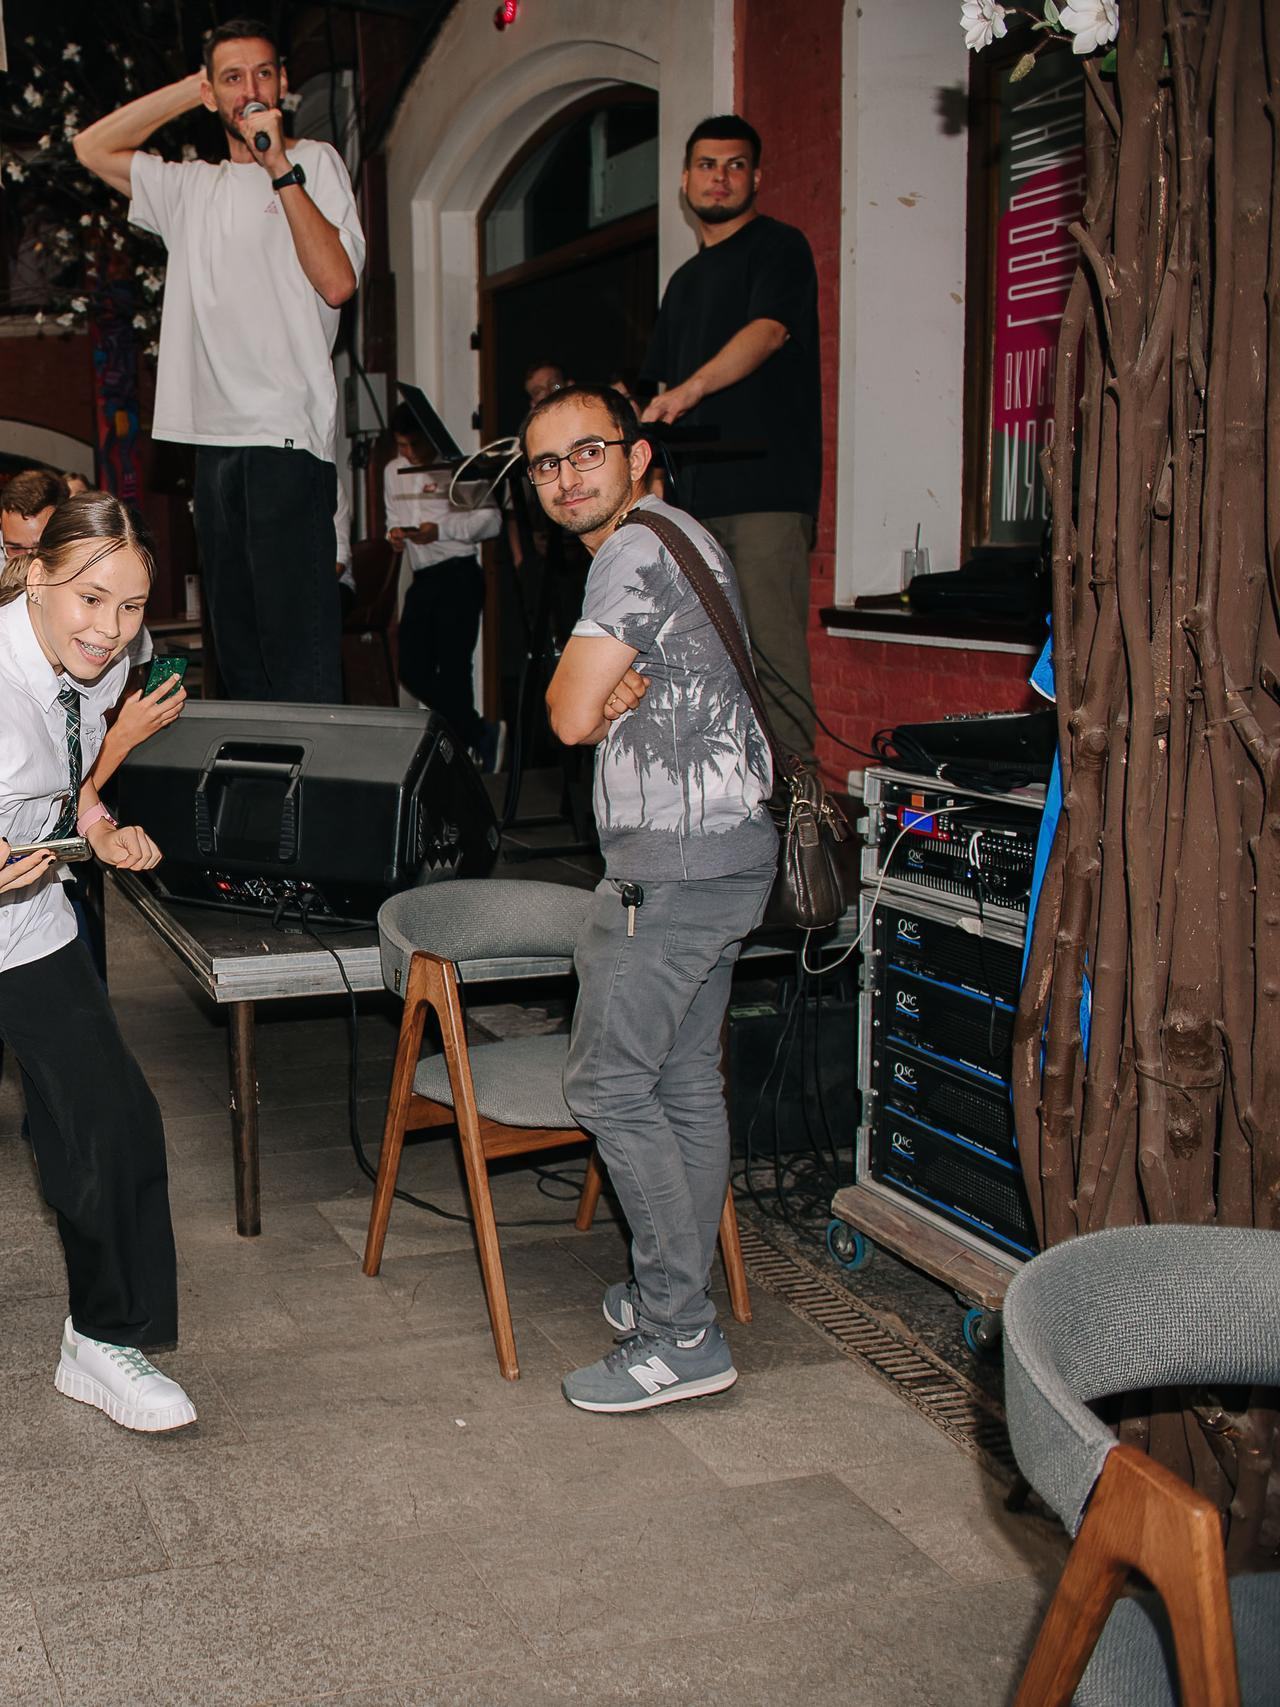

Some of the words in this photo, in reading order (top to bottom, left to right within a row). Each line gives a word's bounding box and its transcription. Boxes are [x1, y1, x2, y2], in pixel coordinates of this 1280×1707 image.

[1007, 75, 1087, 327] ГОВЯДИНА
[897, 919, 920, 940] QSC
[896, 991, 919, 1012] QSC
[894, 1062, 917, 1085] QSC
[892, 1132, 915, 1155] QSC
